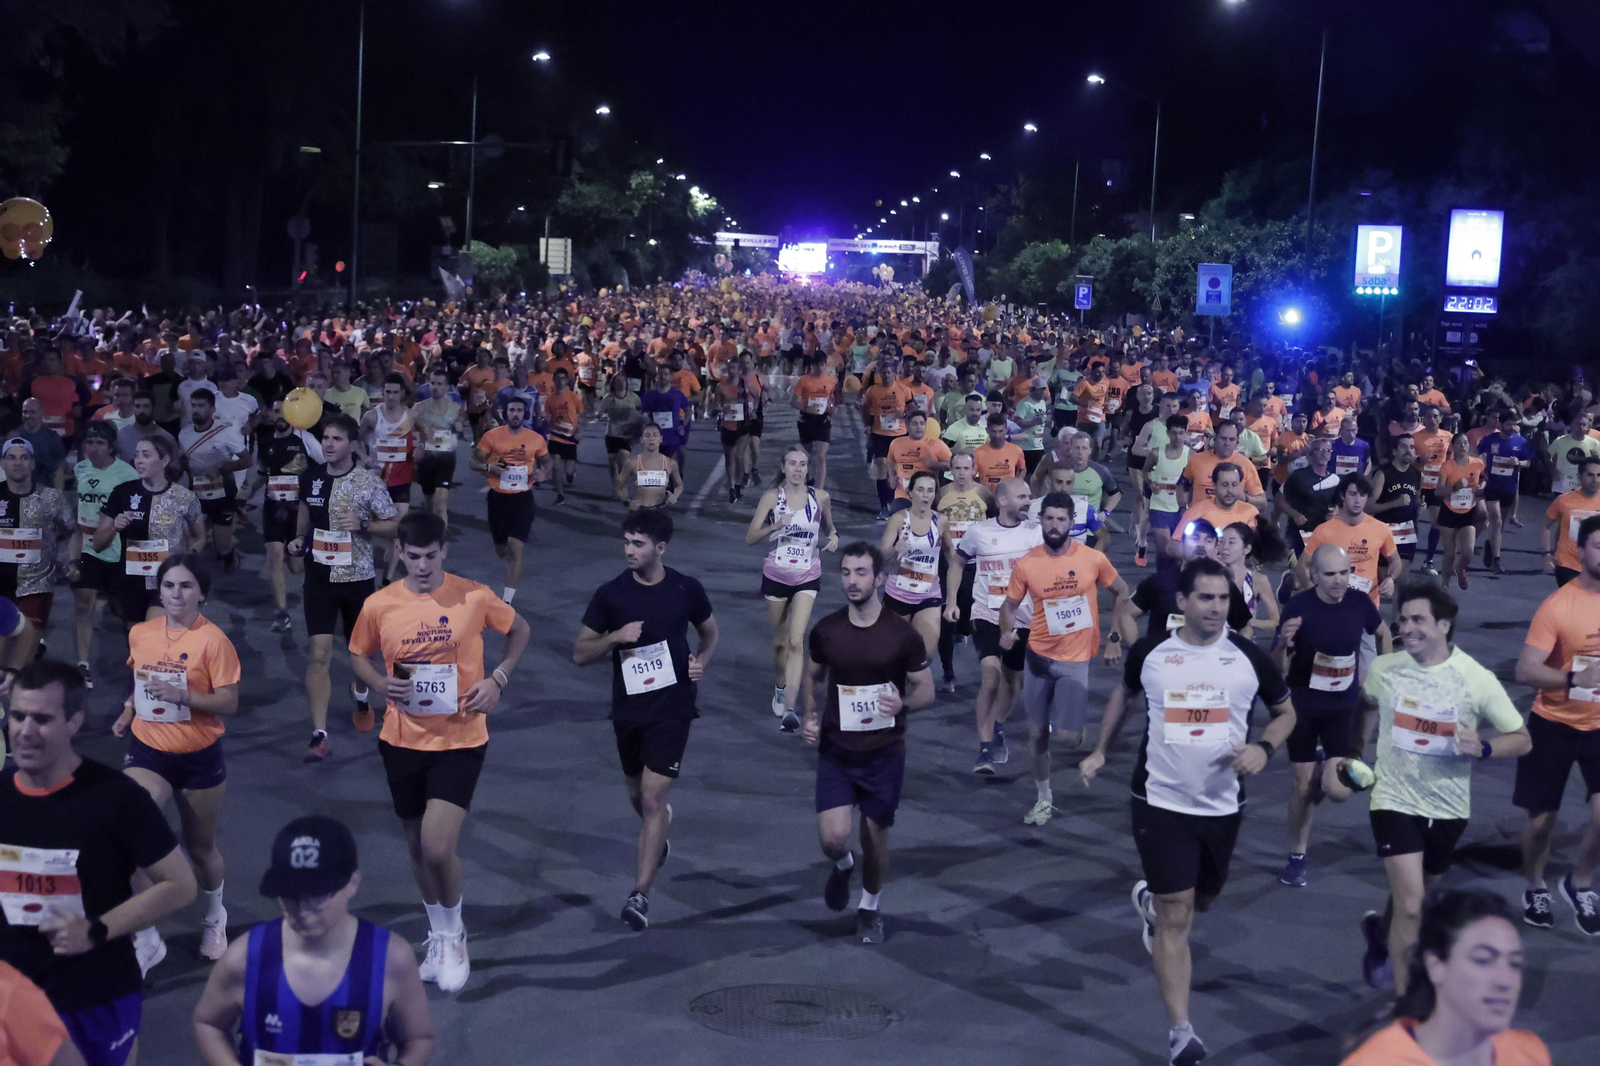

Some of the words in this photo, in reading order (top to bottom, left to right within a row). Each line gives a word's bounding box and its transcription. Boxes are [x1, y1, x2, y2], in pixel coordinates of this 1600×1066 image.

[1368, 231, 1393, 266] P
[1362, 276, 1387, 285] saba
[1080, 286, 1089, 299] P
[1447, 296, 1494, 311] 22:02
[1388, 484, 1401, 493] LOS
[12, 540, 32, 550] 1357
[323, 542, 339, 552] 819
[786, 546, 805, 557] 5303
[138, 552, 160, 562] 1355
[909, 571, 924, 581] 830
[1056, 607, 1082, 621] 15019
[417, 628, 453, 637] NOCTURNA
[401, 637, 432, 646] SEVILLA
[631, 658, 663, 675] 15119
[1164, 653, 1185, 667] edp
[416, 681, 446, 694] 5763
[850, 700, 880, 713] 1511
[1187, 709, 1210, 722] 707
[1415, 718, 1438, 735] 708
[291, 847, 319, 868] 02
[16, 873, 56, 894] 1013
